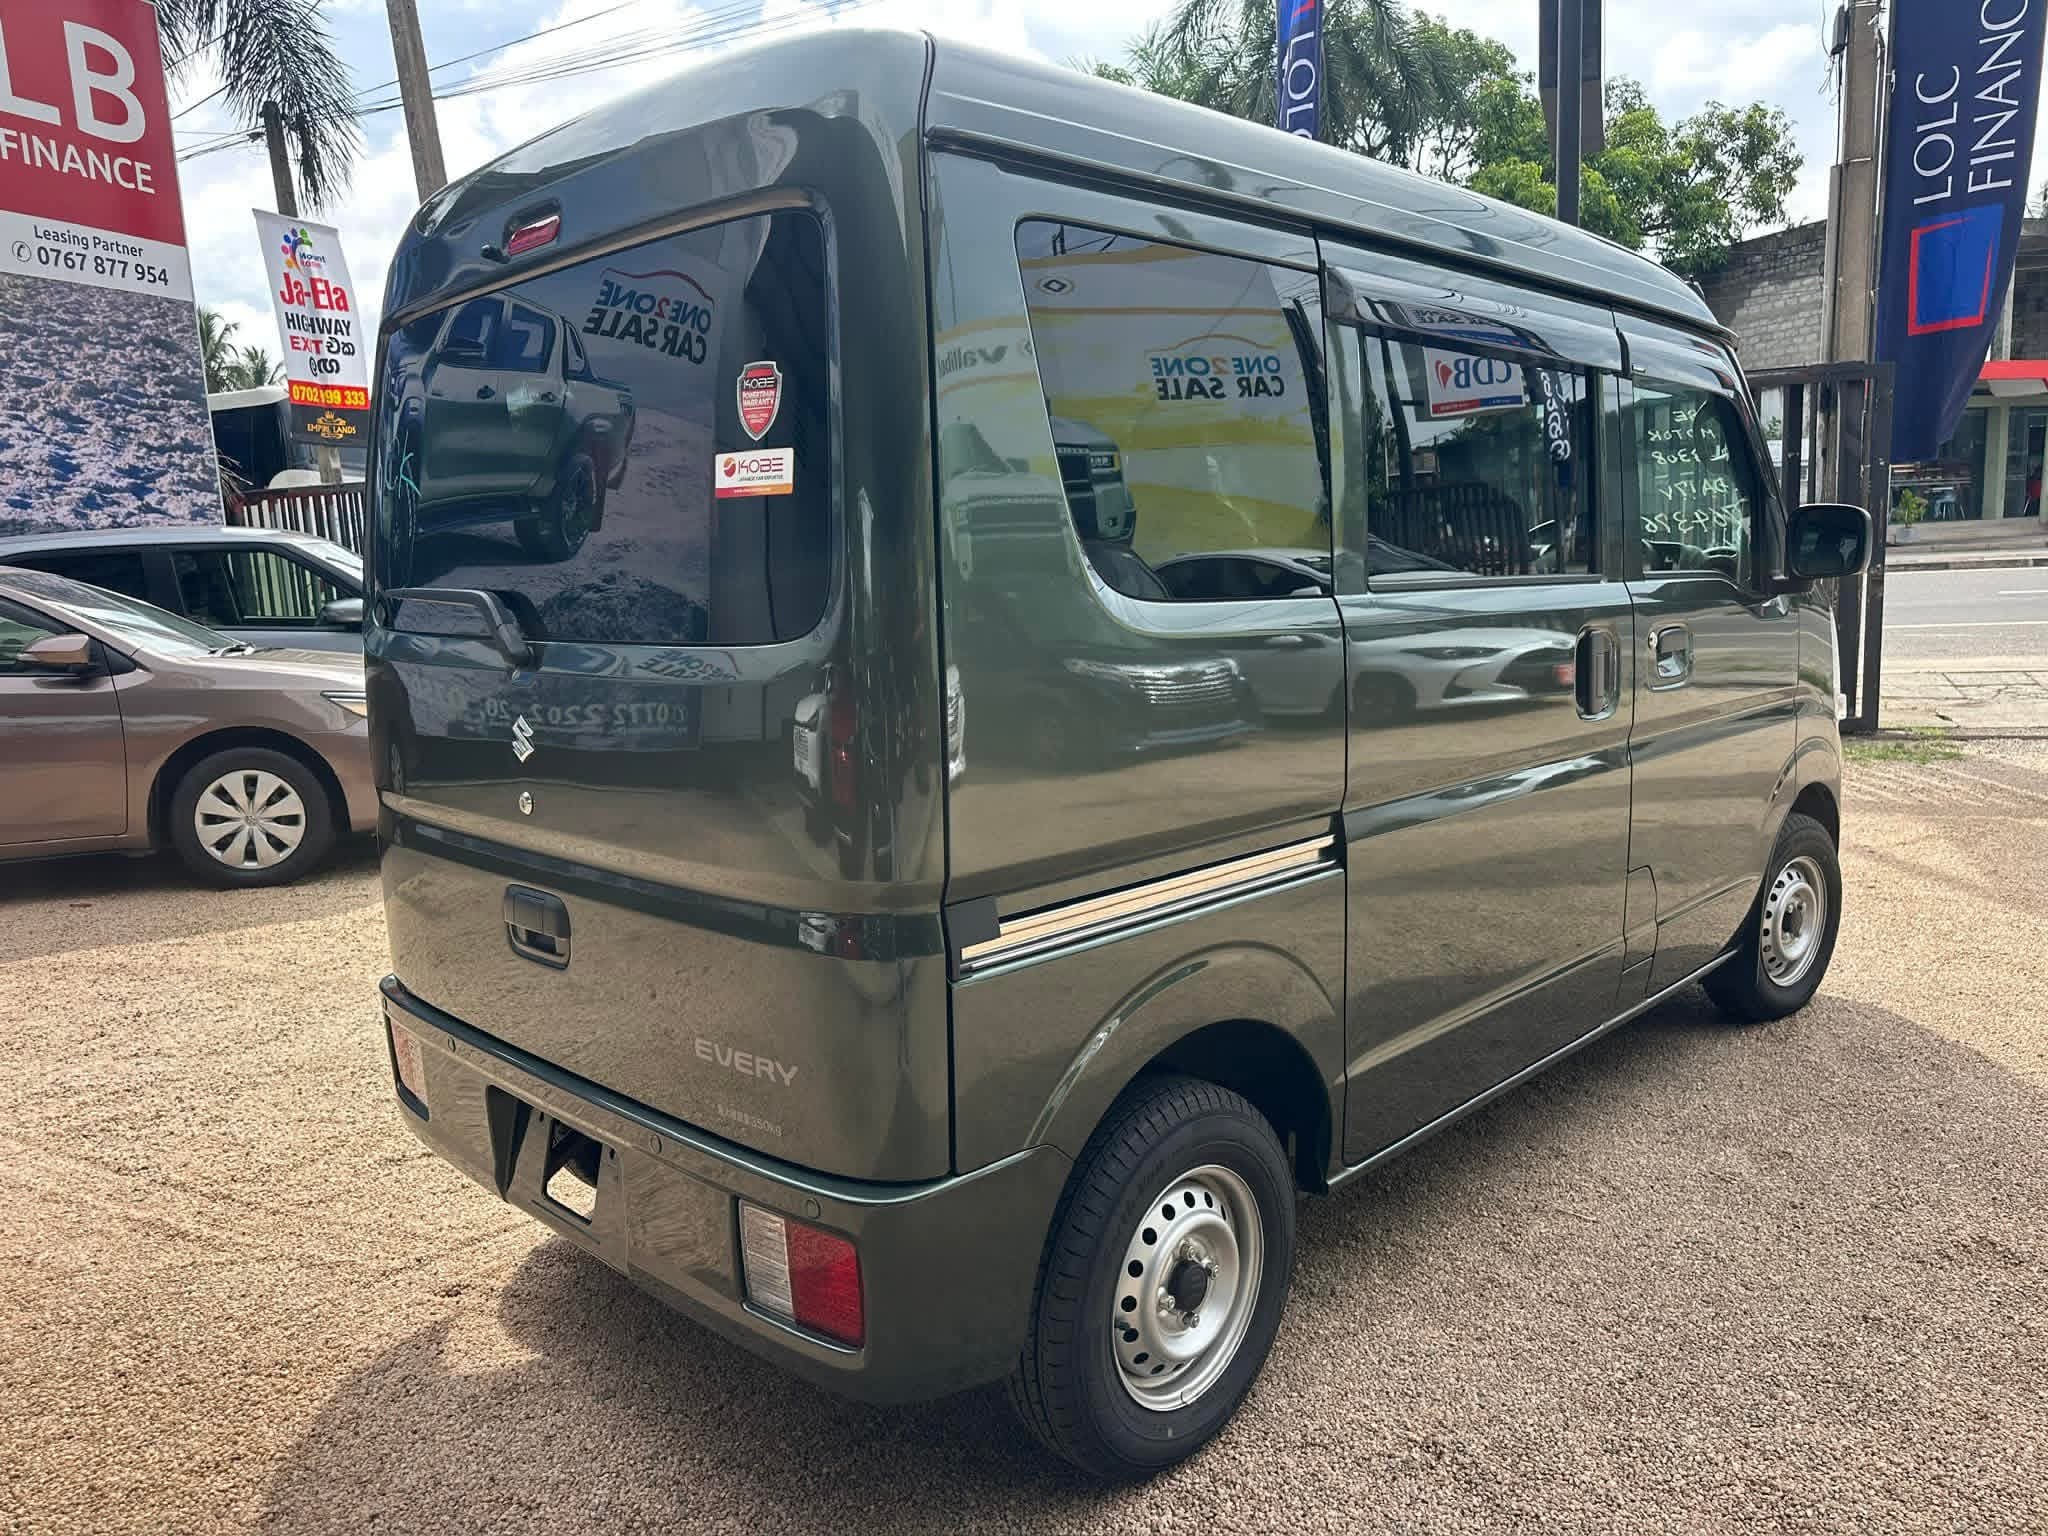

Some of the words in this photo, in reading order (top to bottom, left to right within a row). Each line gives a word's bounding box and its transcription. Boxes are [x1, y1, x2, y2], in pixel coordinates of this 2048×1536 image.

[0, 18, 146, 143] LB
[1286, 31, 1316, 140] LOL
[1913, 65, 1960, 205] LOLC
[0, 127, 156, 194] FINANCE
[33, 225, 89, 250] Leasing
[92, 236, 144, 257] Partner
[37, 245, 87, 271] 0767
[93, 255, 129, 279] 877
[134, 263, 169, 286] 954
[280, 271, 350, 312] Ja-Ela
[285, 312, 351, 337] HIGHWAY
[344, 391, 366, 405] 333
[743, 377, 776, 389] KOBE
[738, 457, 784, 474] KOBE
[695, 1038, 799, 1087] EVERY
